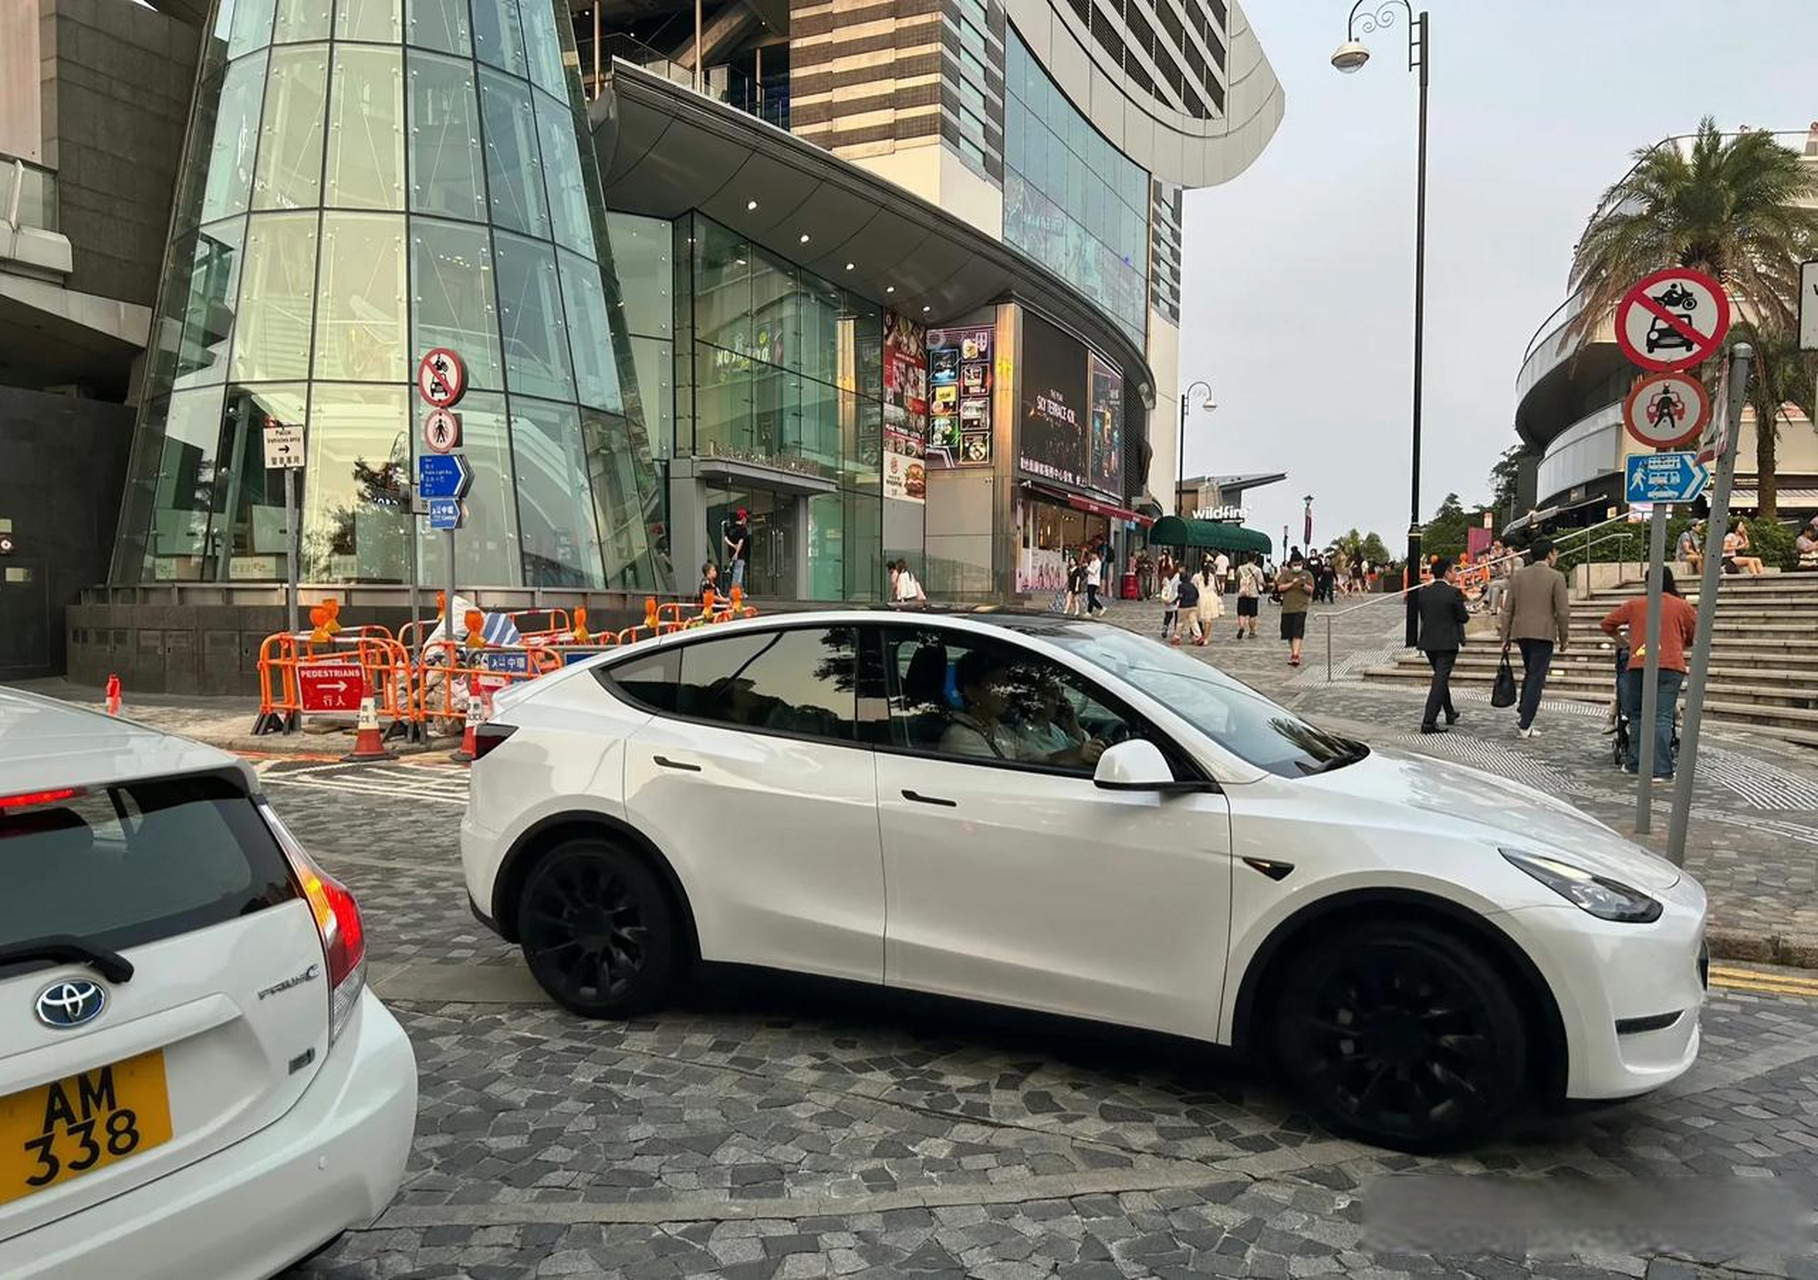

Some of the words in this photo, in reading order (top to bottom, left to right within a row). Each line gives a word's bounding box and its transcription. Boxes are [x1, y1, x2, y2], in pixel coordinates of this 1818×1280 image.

[1047, 399, 1067, 420] TERRACE
[1192, 506, 1247, 519] wildfire
[507, 657, 525, 669] 中環
[301, 669, 360, 678] PEDESTRIANS
[323, 695, 346, 706] 行人
[43, 1066, 117, 1136] AM
[24, 1109, 140, 1186] 338
